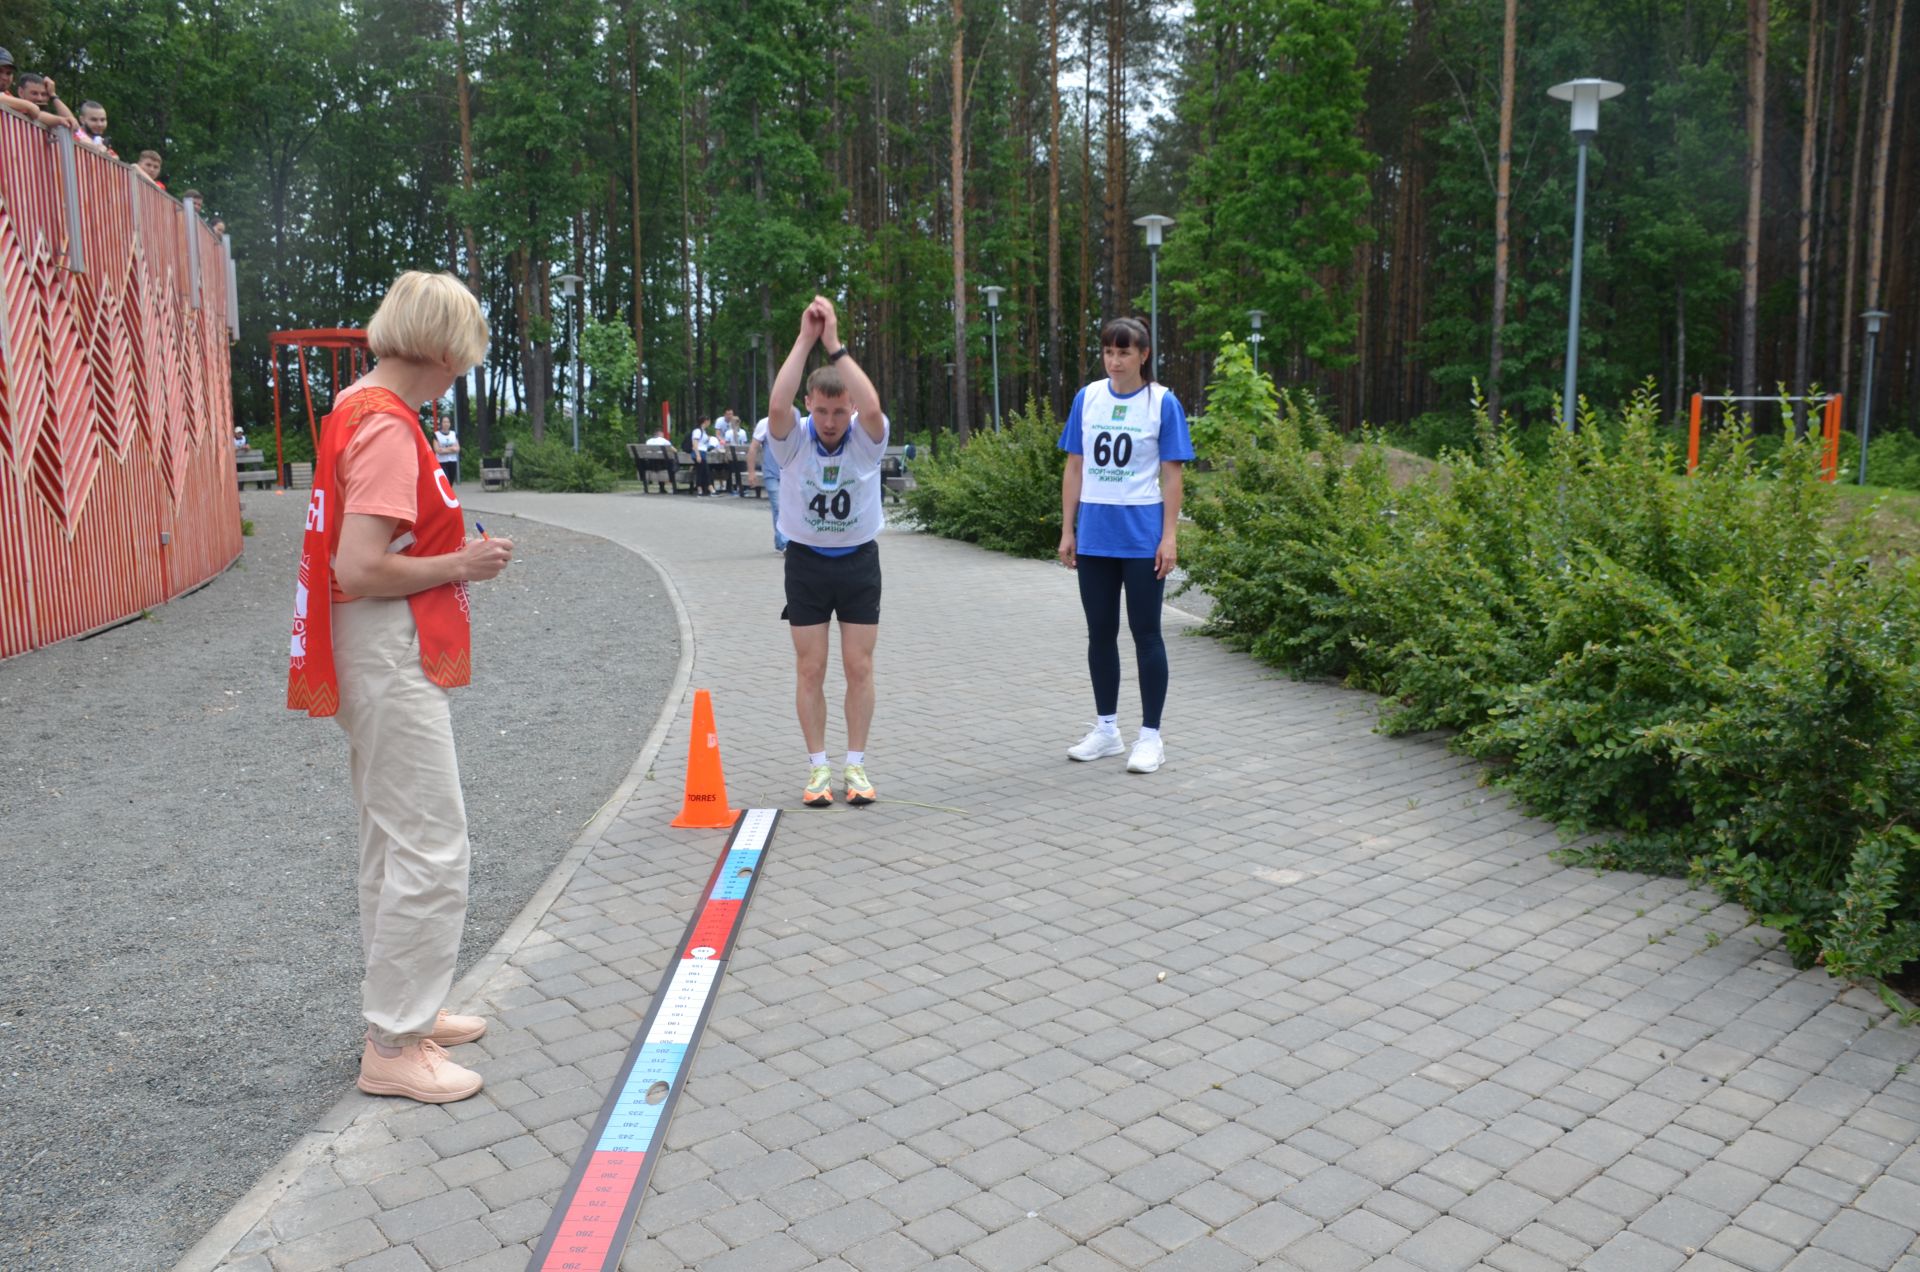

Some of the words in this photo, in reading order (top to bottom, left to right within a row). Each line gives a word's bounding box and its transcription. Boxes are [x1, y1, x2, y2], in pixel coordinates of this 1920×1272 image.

[1094, 431, 1132, 468] 60
[809, 489, 850, 520] 40
[688, 794, 716, 802] TORRES
